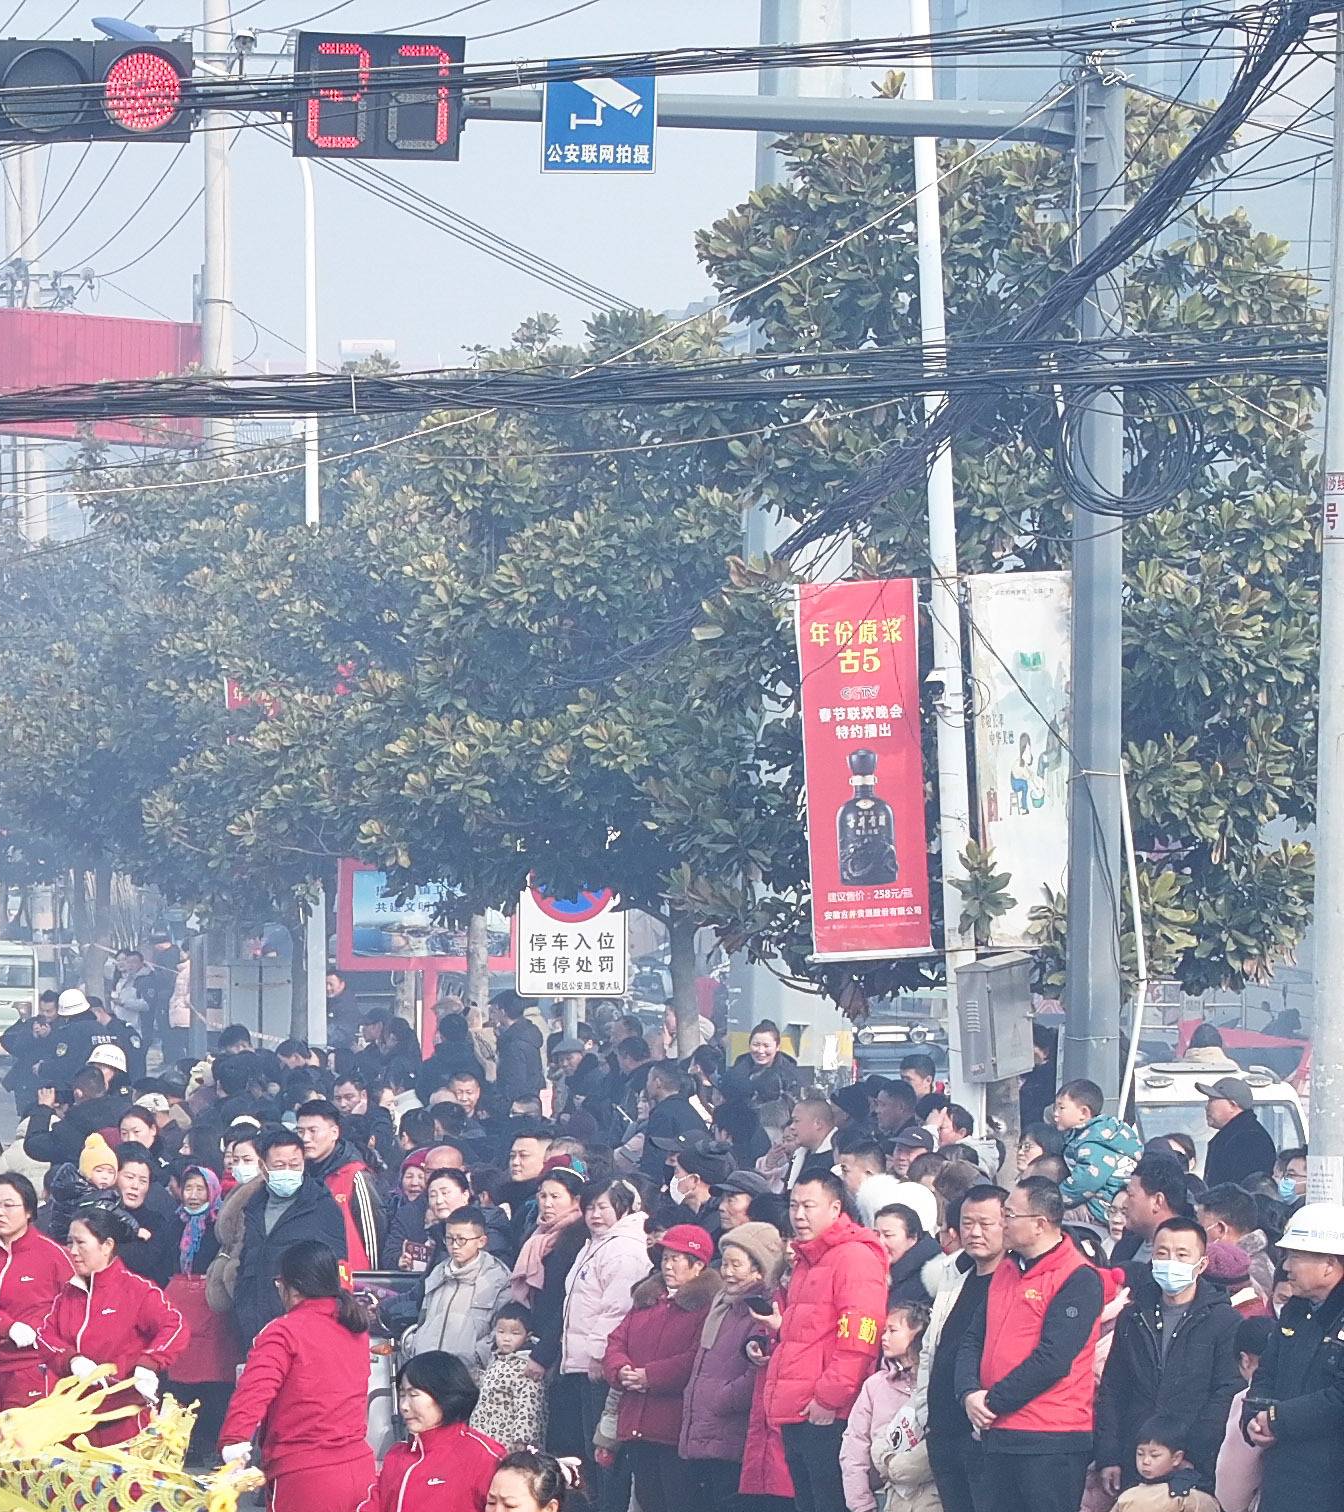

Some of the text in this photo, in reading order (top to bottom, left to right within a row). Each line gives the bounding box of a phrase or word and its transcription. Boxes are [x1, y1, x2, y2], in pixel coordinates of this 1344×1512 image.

[547, 143, 650, 164] 公安联网拍摄
[809, 617, 904, 647] 年份原浆
[838, 647, 881, 674] 古5
[819, 703, 903, 723] 春节联欢晚会
[835, 722, 892, 740] 特约播出
[529, 931, 615, 952] 停车入位
[529, 955, 615, 974] 违停处罚
